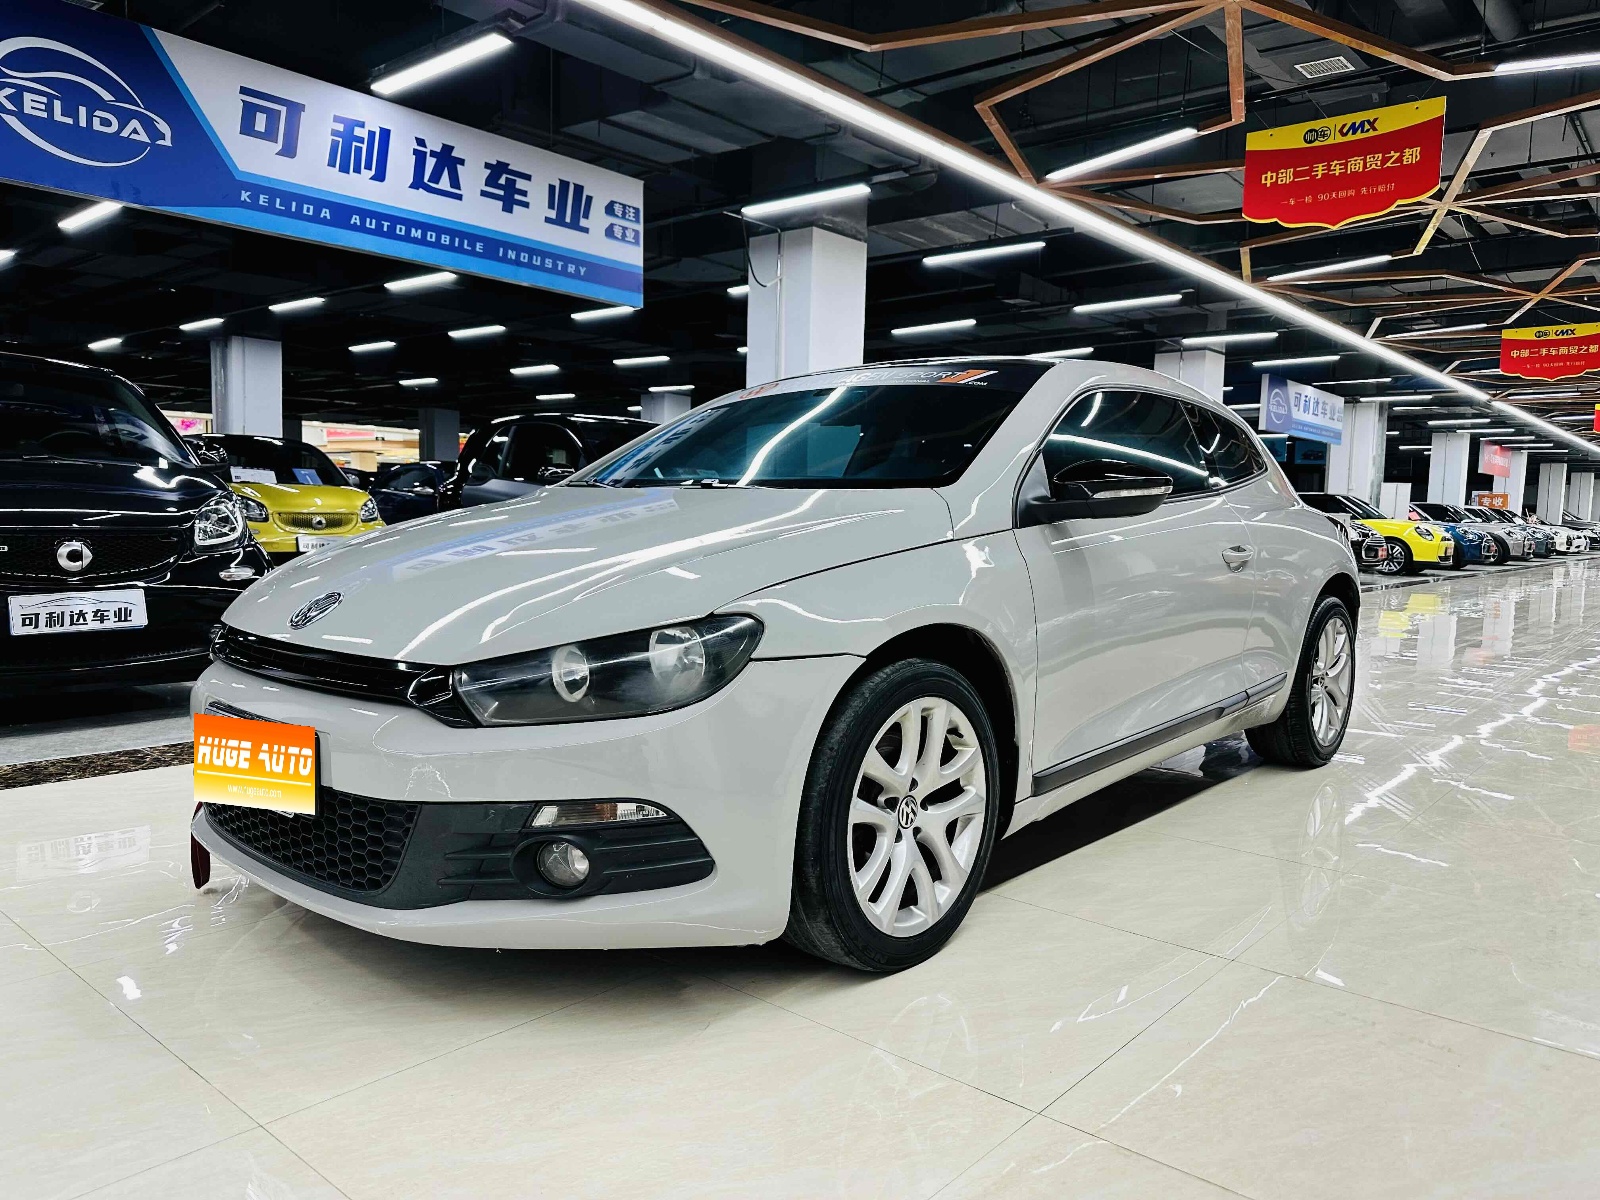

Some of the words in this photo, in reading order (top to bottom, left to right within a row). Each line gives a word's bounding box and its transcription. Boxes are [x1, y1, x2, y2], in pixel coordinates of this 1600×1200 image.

[239, 85, 593, 234] 可利达车业
[1261, 147, 1421, 188] 中部二手车商贸之都
[613, 202, 636, 221] 专注
[240, 190, 331, 220] KELIDA
[350, 214, 484, 253] AUTOMOBILE
[499, 248, 587, 277] INDUSTRY
[613, 225, 636, 243] 专业
[1510, 344, 1599, 359] 中部二手车商贸之都
[20, 607, 133, 630] 可利达车业
